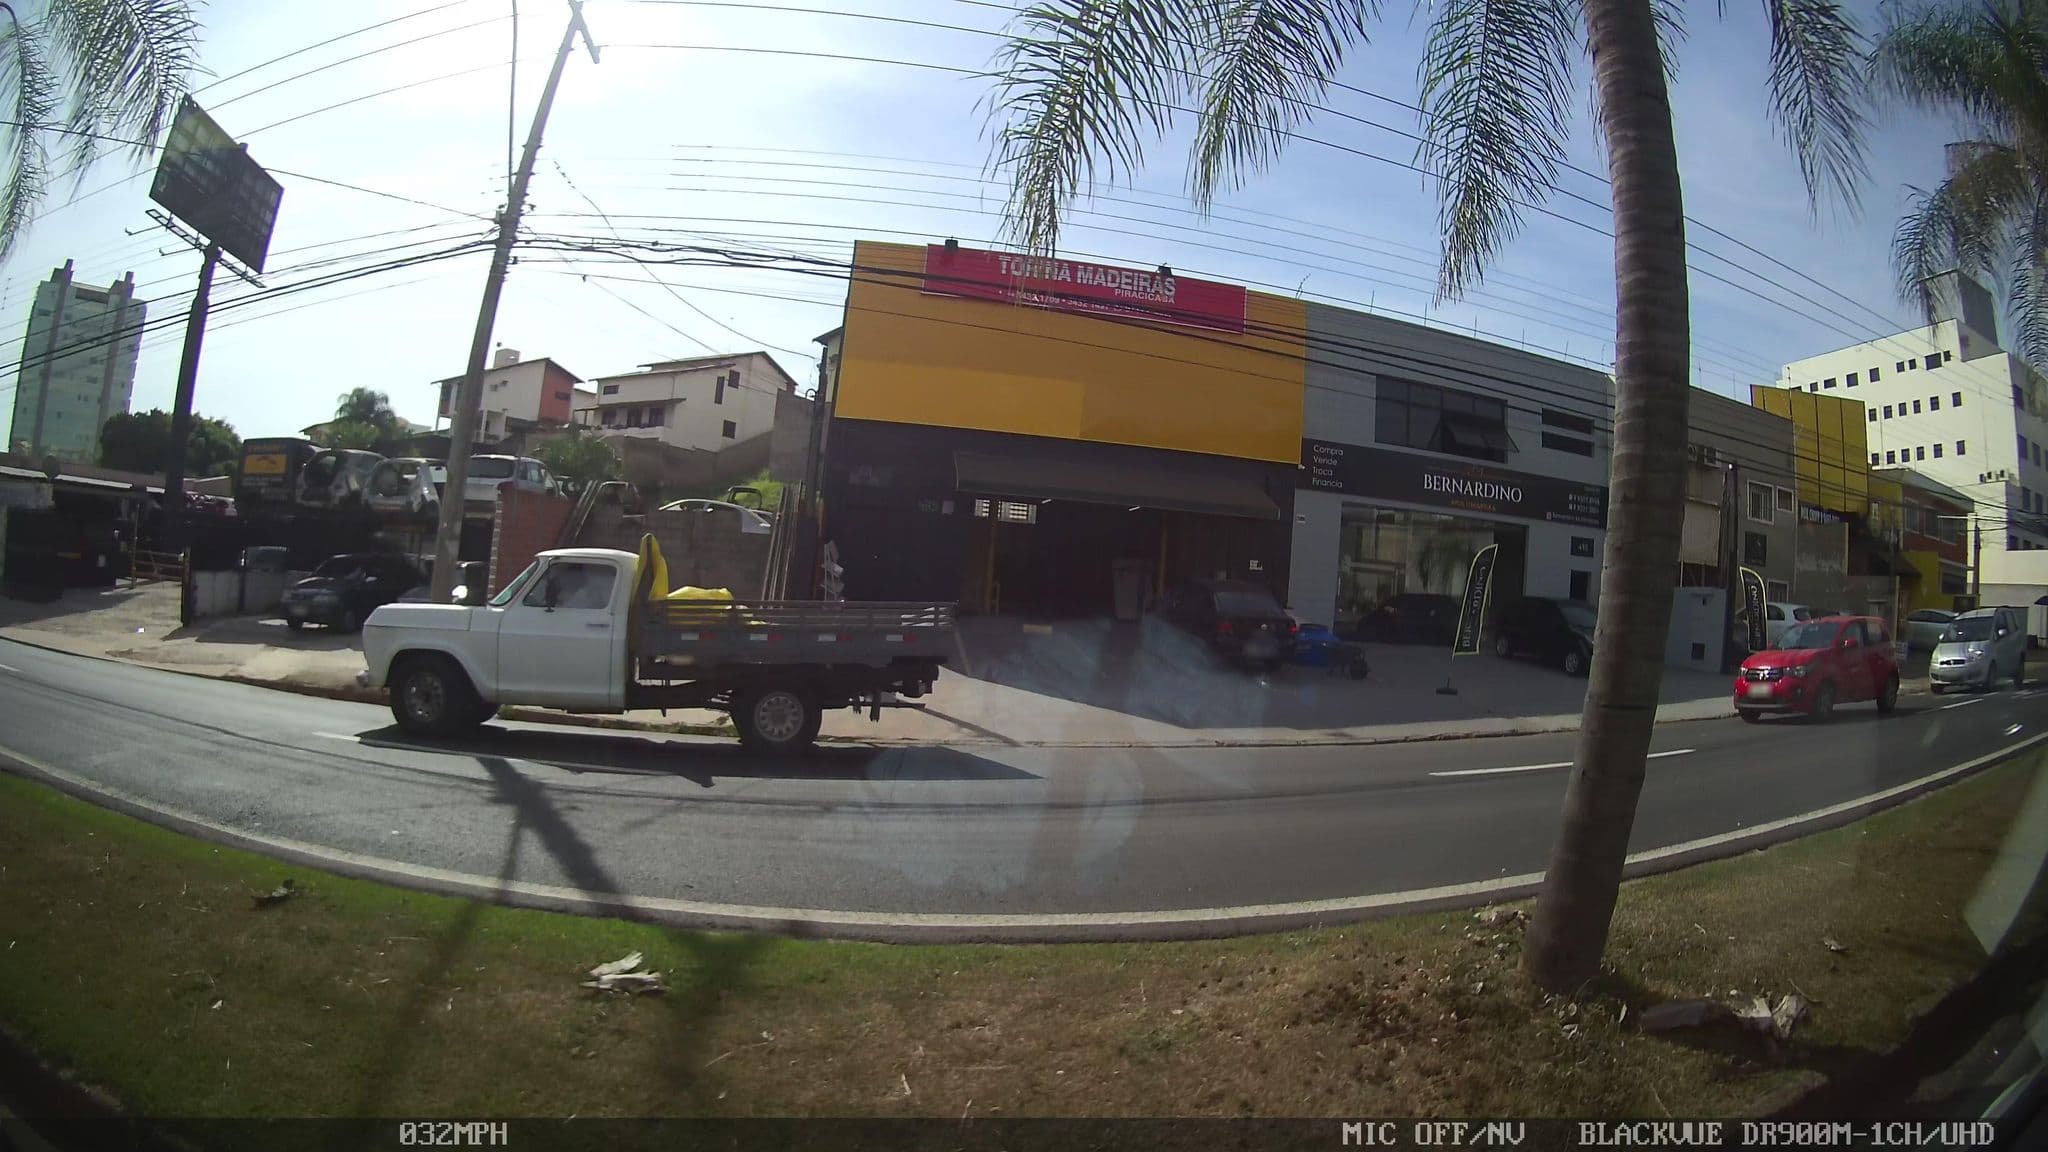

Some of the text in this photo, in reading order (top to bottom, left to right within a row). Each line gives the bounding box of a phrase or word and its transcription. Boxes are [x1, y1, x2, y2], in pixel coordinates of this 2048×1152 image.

[999, 255, 1175, 296] TORNA MADEIRAS
[1313, 444, 1344, 456] Compra
[1313, 455, 1338, 466] Vende
[1312, 466, 1333, 476] Troca
[1312, 477, 1343, 489] Financia
[1424, 473, 1522, 503] BERNARDINO
